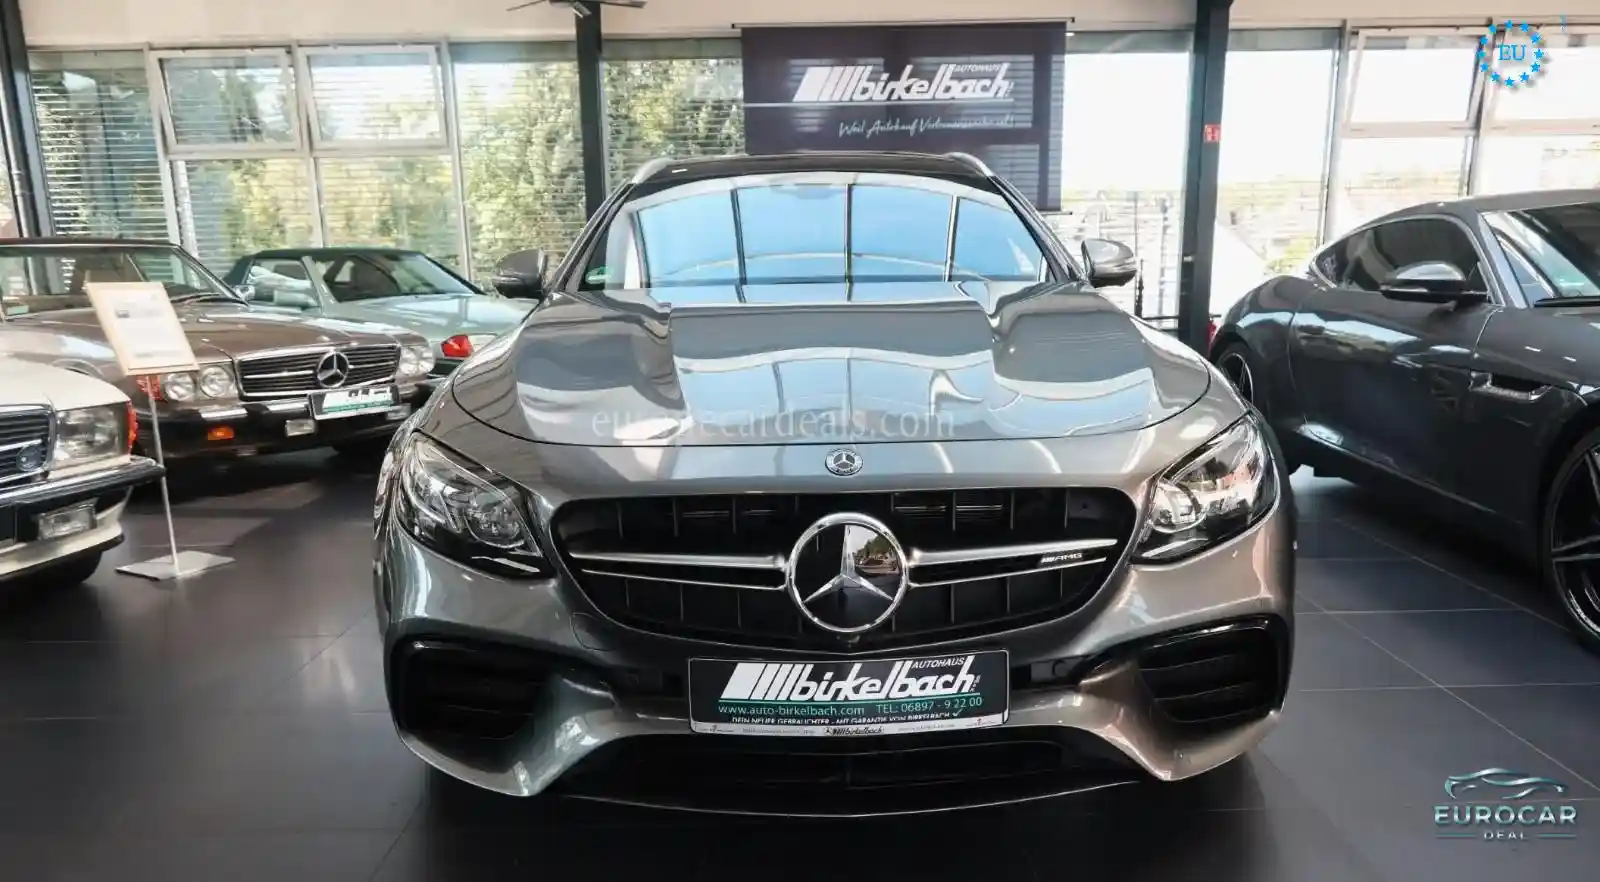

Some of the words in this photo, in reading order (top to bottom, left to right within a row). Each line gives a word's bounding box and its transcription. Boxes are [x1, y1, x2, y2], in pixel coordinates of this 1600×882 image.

[912, 657, 965, 669] AUTOHAUS
[789, 655, 976, 701] birkelbach
[718, 704, 865, 716] www.auto-birkelbach.com
[876, 703, 898, 714] TEL:
[901, 701, 934, 713] 06897
[944, 699, 951, 709] 9
